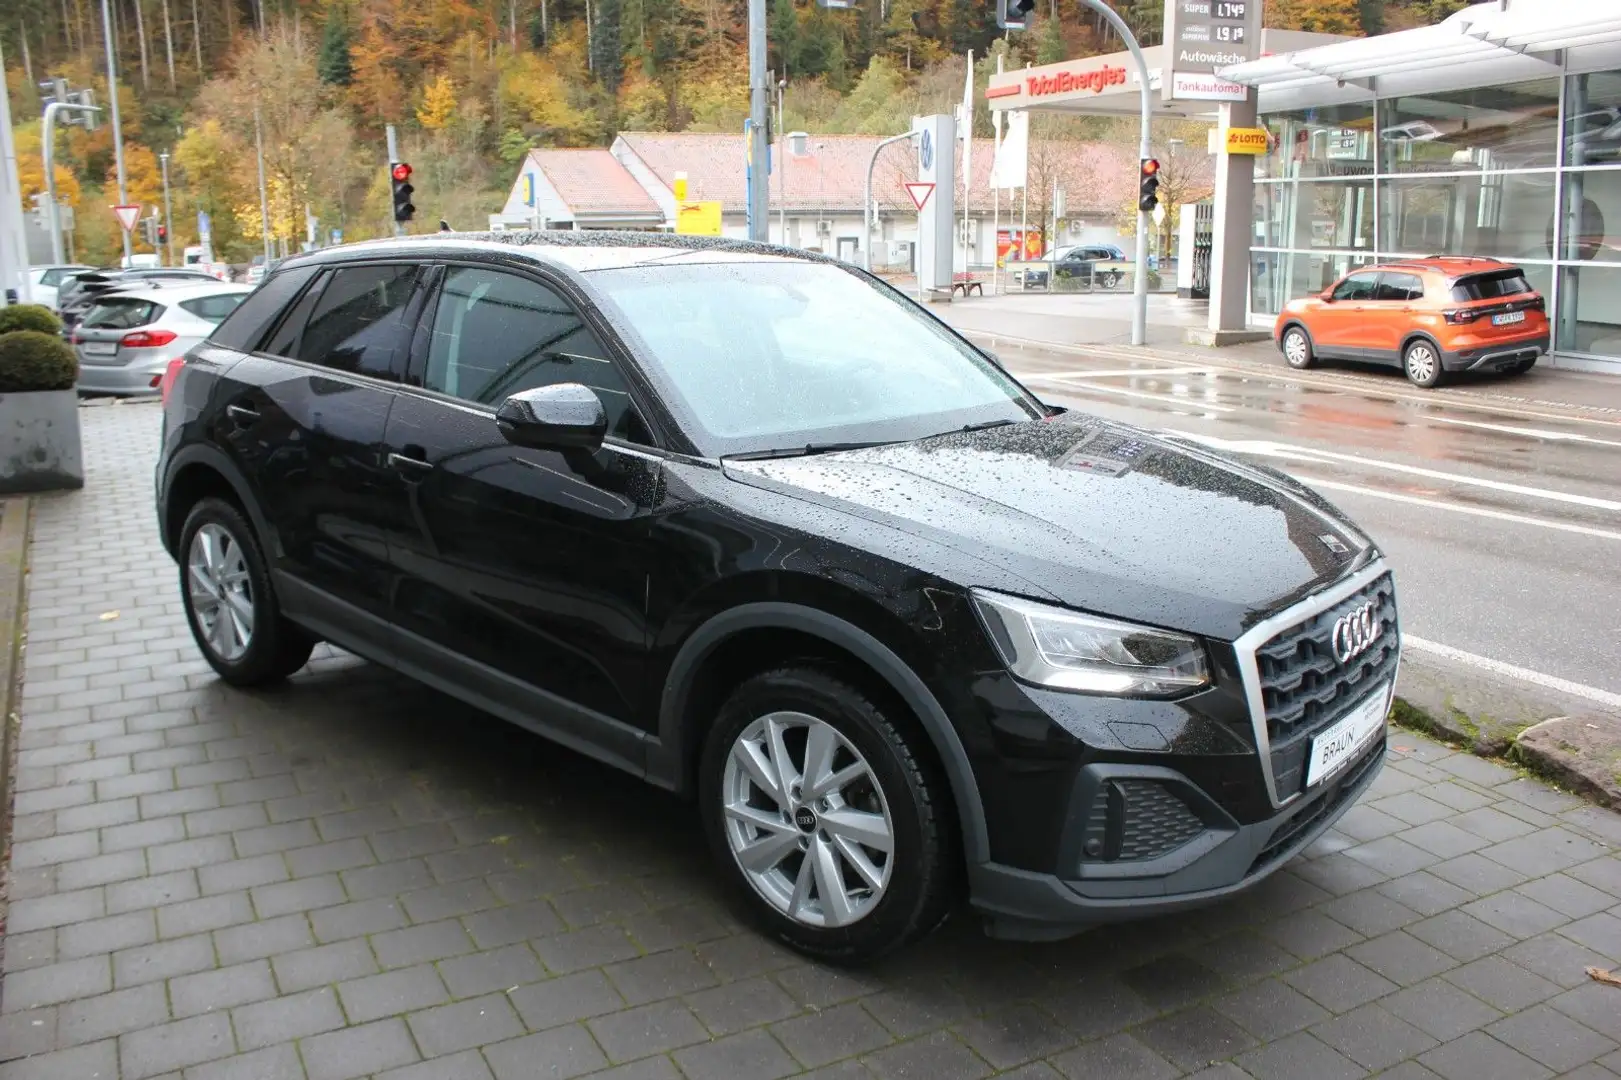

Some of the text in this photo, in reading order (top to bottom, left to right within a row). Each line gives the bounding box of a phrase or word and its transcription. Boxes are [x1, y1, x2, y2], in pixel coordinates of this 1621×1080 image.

[1184, 3, 1209, 14] SUPER
[1180, 49, 1246, 64] Autowäsche
[1026, 64, 1126, 96] TotalEnergies
[1177, 80, 1244, 95] Tankautomat
[1240, 134, 1266, 144] LOTTO
[1322, 726, 1355, 765] BRAUN
